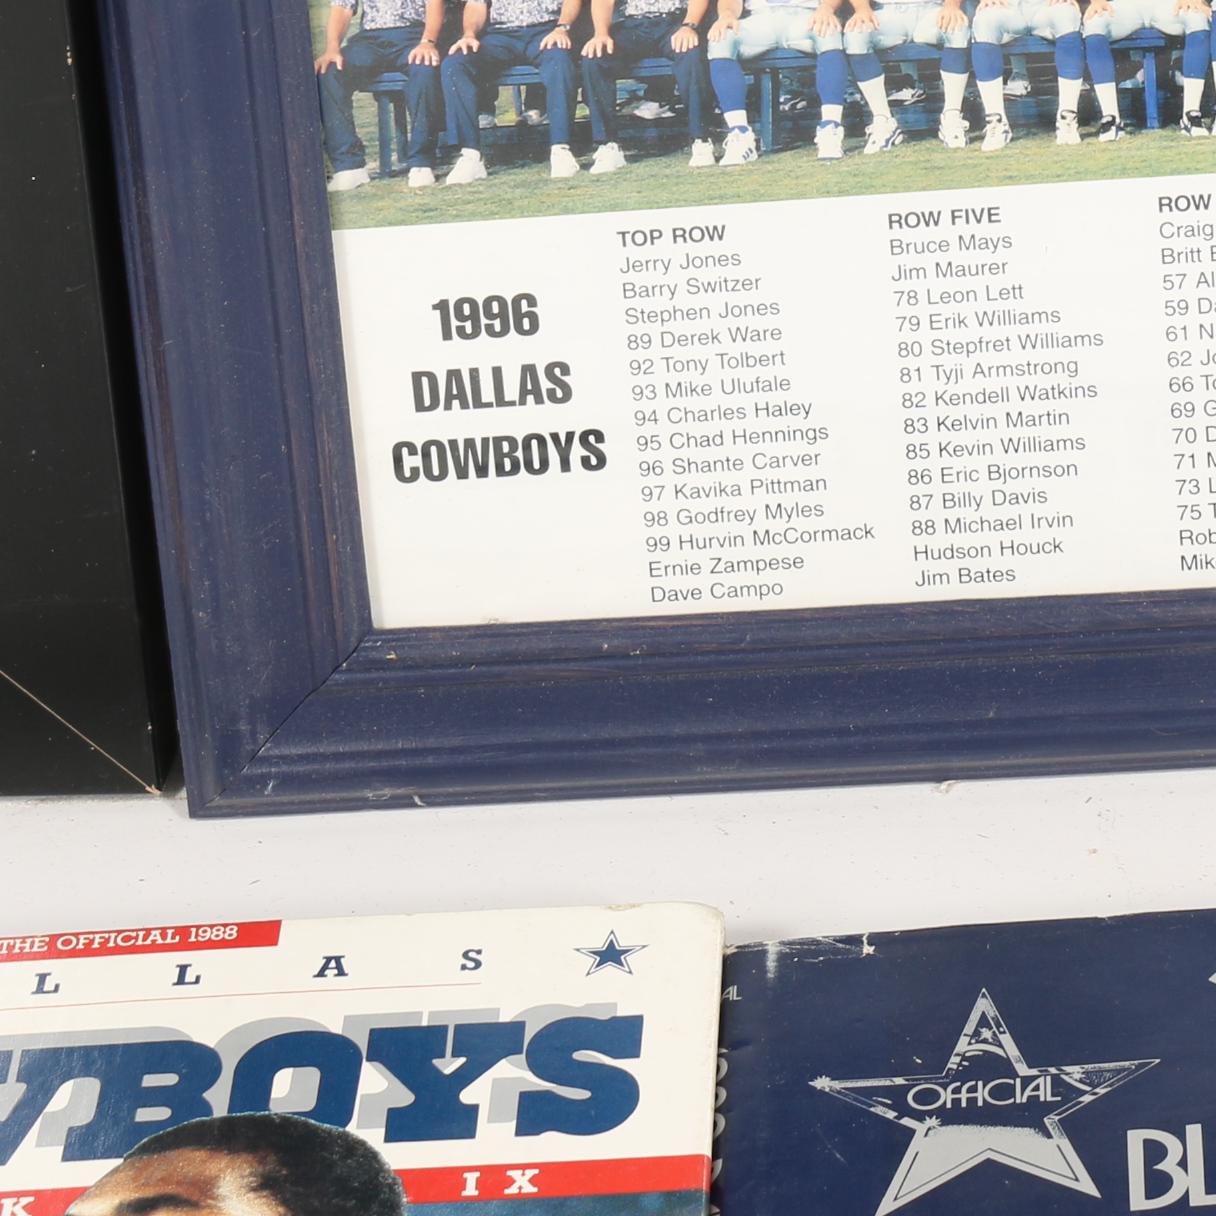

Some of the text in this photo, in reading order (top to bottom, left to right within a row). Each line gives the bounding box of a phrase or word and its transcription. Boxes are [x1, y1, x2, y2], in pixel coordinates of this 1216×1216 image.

[1157, 193, 1212, 214] ROW
[887, 206, 1002, 230] ROW FIVE
[616, 224, 726, 248] TOP ROW
[1159, 221, 1214, 242] Craig
[619, 252, 742, 276] Jerry Jones
[893, 284, 1024, 307] 78 Leon Lett
[1164, 298, 1189, 317] 59
[431, 293, 540, 341] 1996
[627, 325, 783, 351] 89 Derek Ware
[897, 332, 1104, 359] 80 Stepfret Williams
[1167, 350, 1192, 368] 62
[411, 361, 573, 412] DALLAS
[631, 375, 791, 402] 93 Mike Ulufale
[903, 410, 1070, 435] 83 Kelvin Martin
[1171, 426, 1197, 444] 70
[391, 428, 608, 484] COWBOYS
[638, 452, 821, 478] 96 Shante Carver
[909, 489, 1048, 512] 87 Billy Davis
[1176, 503, 1202, 521] 75
[645, 522, 875, 553] 99 Hurvin McCormack
[913, 537, 1064, 562] Hudson Houck
[0, 925, 239, 954] THE OFFICIAL 1988
[907, 1075, 1062, 1111] OFFICIAL
